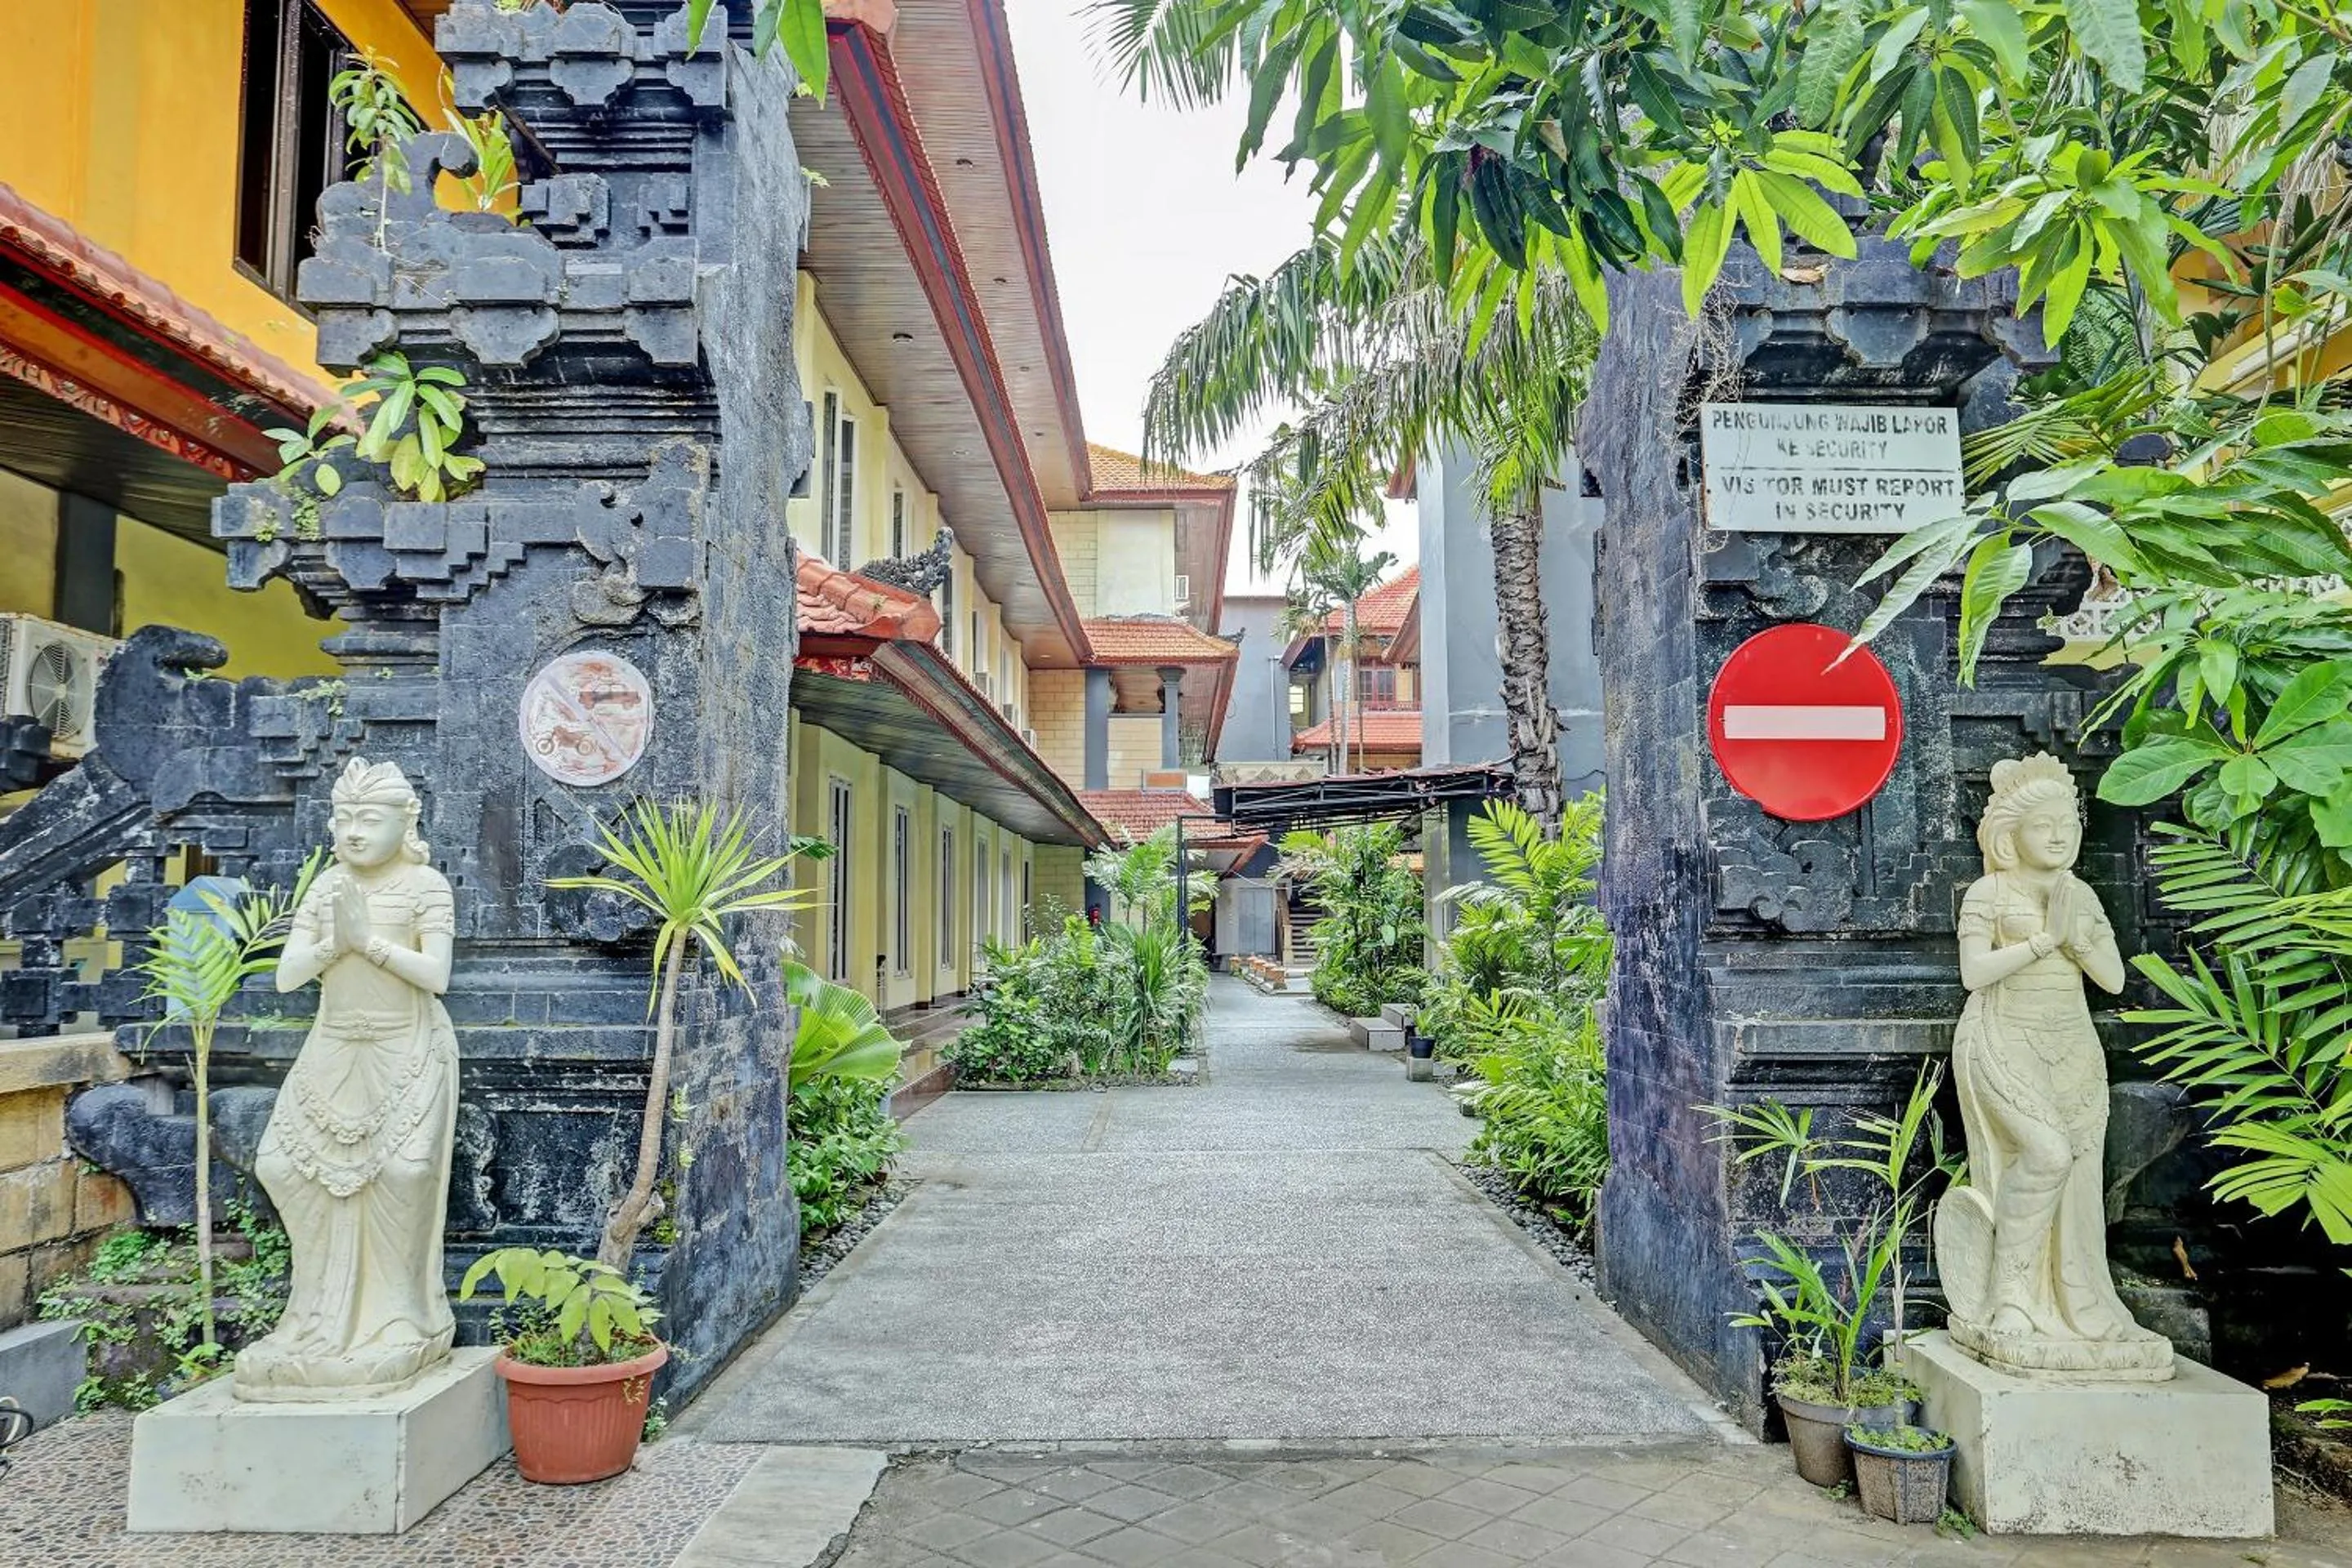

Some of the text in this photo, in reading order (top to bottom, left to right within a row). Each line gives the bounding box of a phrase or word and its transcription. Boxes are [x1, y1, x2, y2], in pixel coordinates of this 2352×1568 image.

[1834, 413, 1887, 434] WAJIB
[1777, 438, 1799, 457] KE
[1722, 476, 1954, 497] VISTOR MUST REPORT
[1775, 501, 1796, 520] IN
